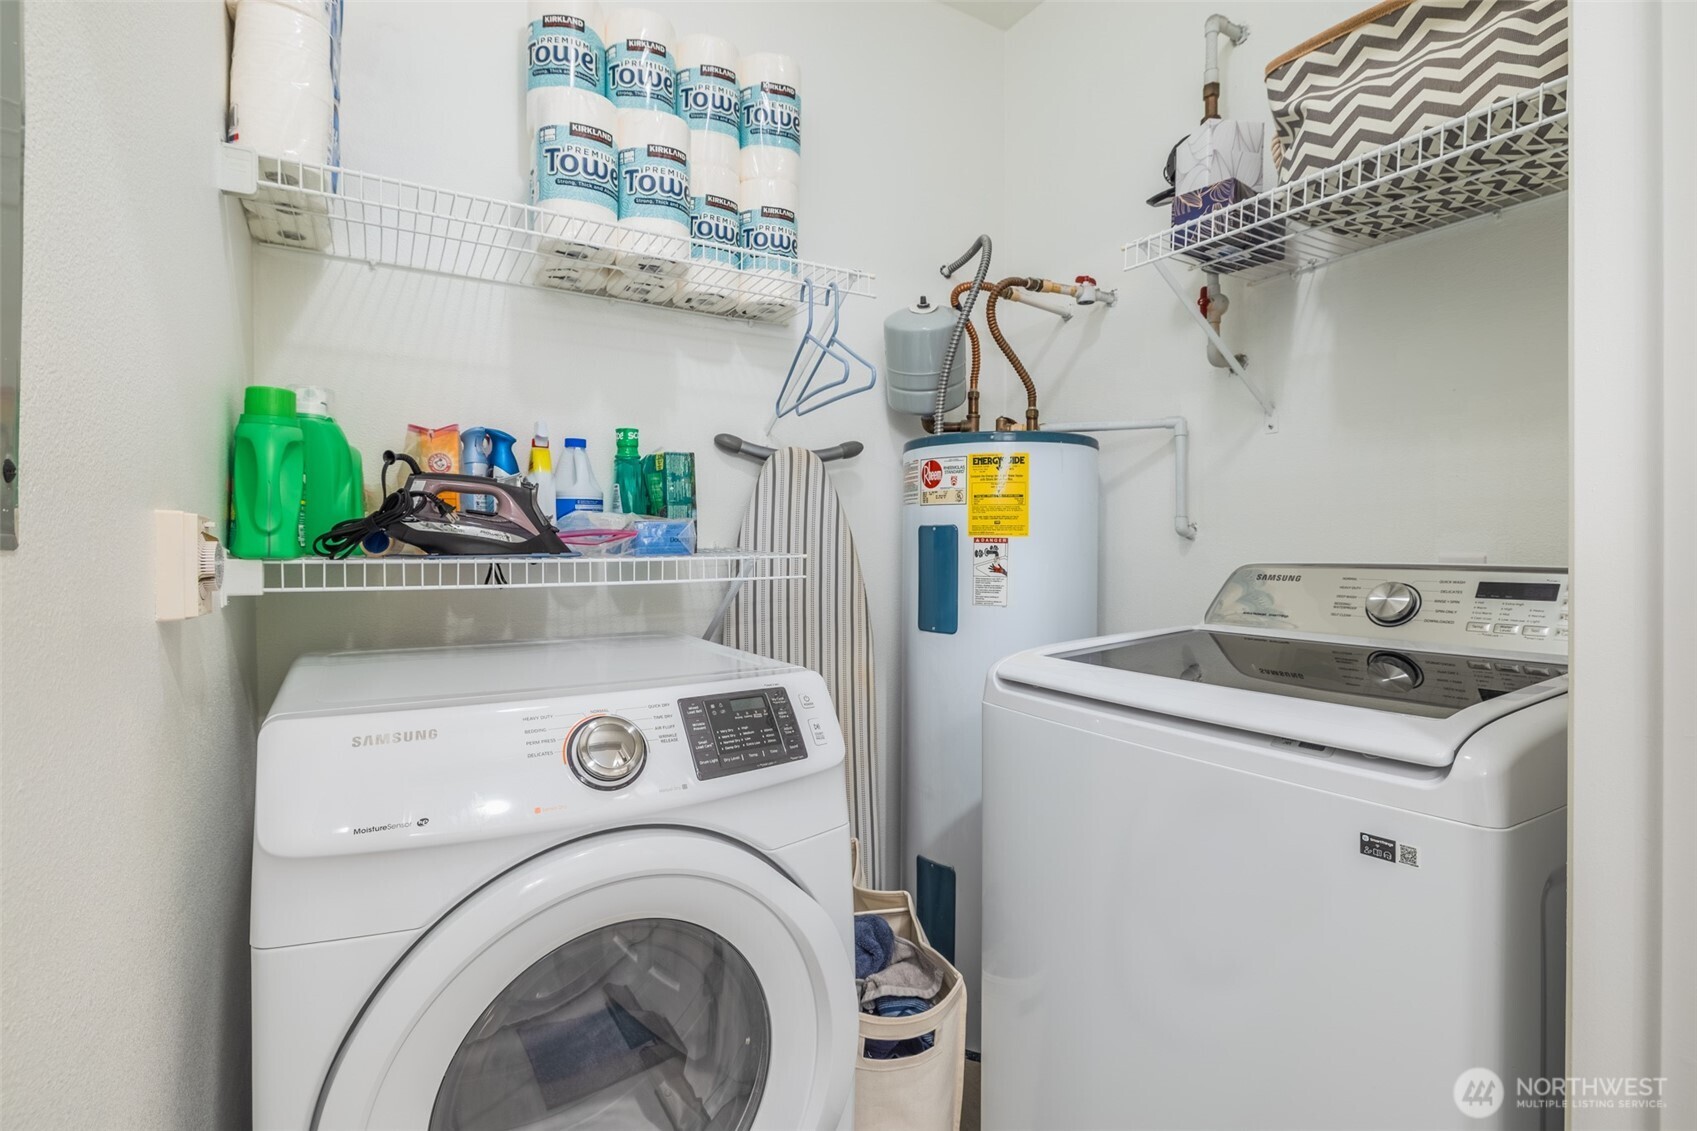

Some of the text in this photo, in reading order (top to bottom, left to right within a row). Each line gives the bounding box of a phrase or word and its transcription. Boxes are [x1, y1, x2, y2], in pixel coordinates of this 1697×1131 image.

[544, 16, 584, 28] KIRKLAND
[540, 36, 590, 49] PREMIUM
[628, 40, 666, 53] KIRKLAND
[528, 43, 598, 80] Towel
[609, 64, 674, 96] Towe
[702, 66, 735, 79] KIRKLAND
[762, 82, 795, 94] KIRKLAND
[681, 88, 740, 118] Towe
[744, 104, 800, 134] Towe
[572, 123, 612, 143] KIRKLAND
[566, 145, 616, 165] PREMIUM
[650, 145, 686, 162] KIRKLAND
[545, 148, 618, 190] Towe
[624, 168, 691, 208] Towe
[708, 196, 738, 210] KIRKLAND
[763, 208, 794, 219] KIRKLAND
[743, 228, 798, 255] Towe
[972, 456, 1025, 465] ENERGYIDE
[923, 461, 942, 485] Rheem
[1256, 573, 1302, 582] SAMSUNG
[352, 728, 438, 748] SAMSUNG
[353, 822, 412, 835] MoistureSensor
